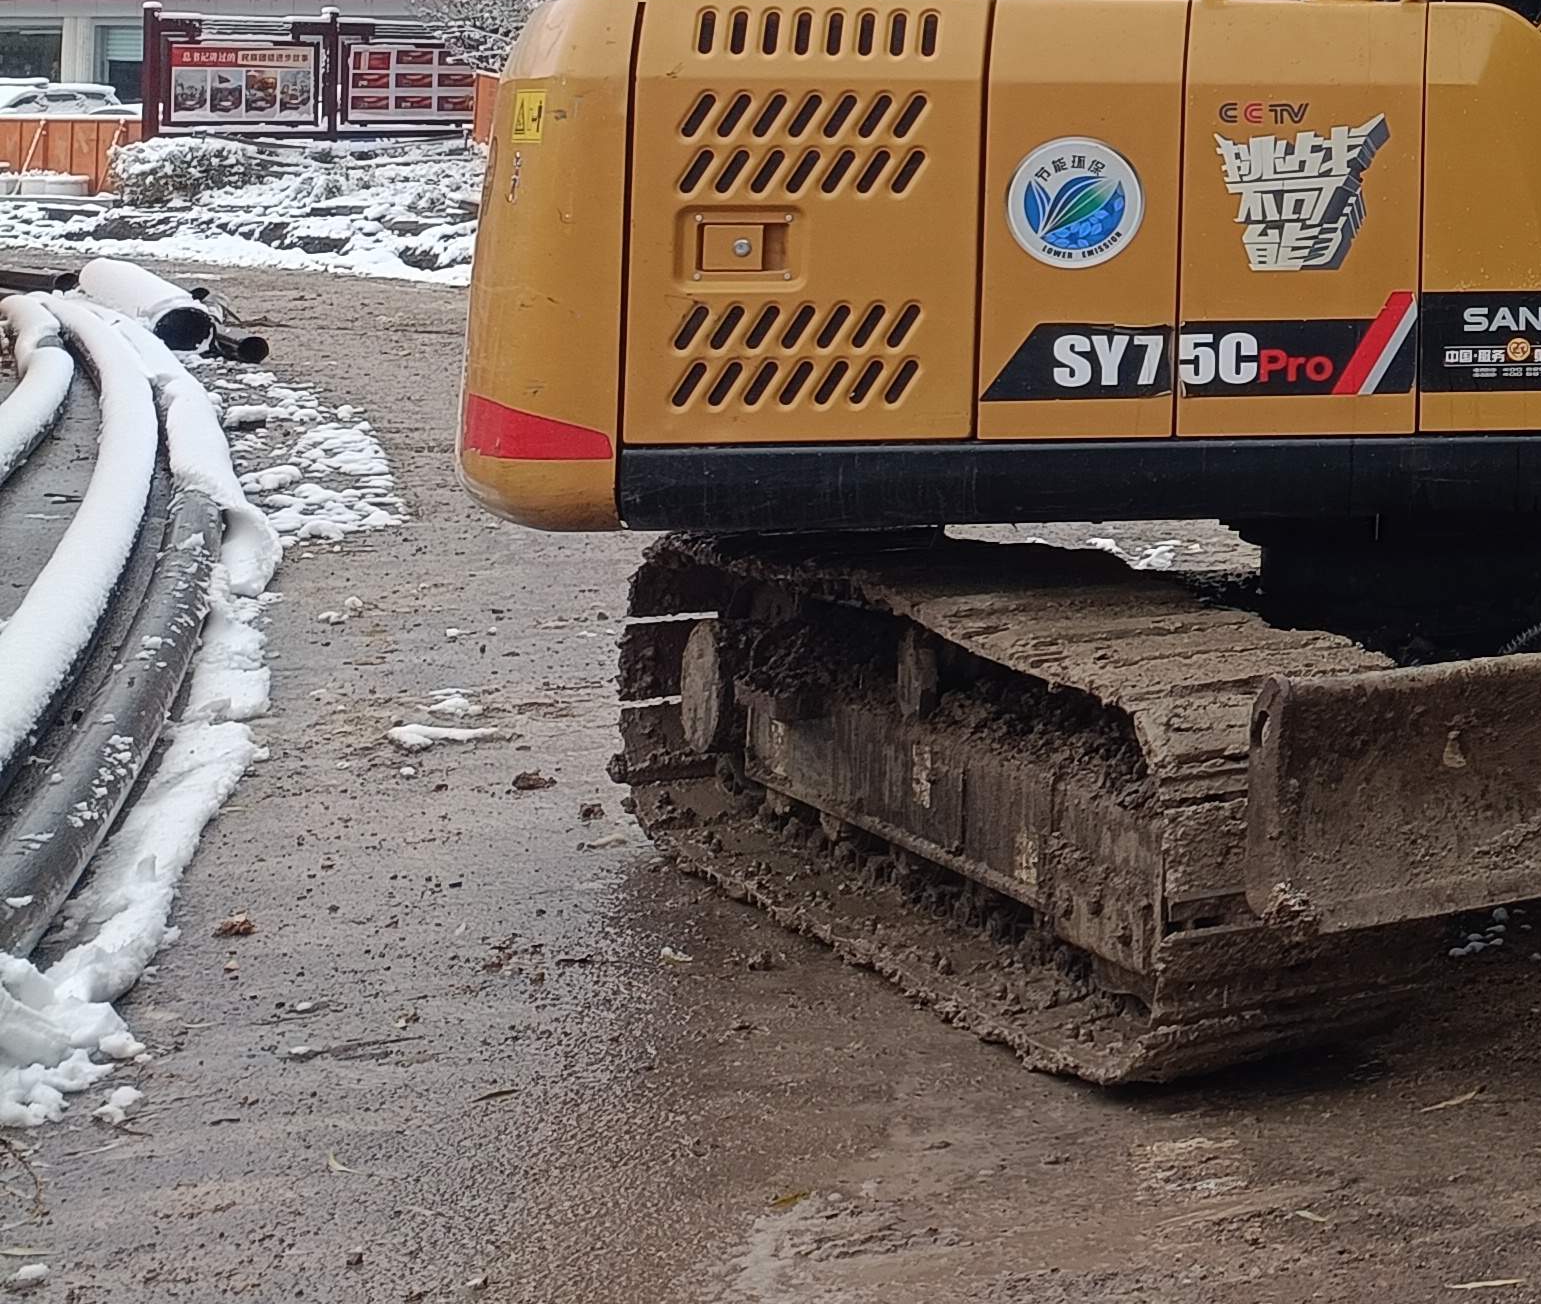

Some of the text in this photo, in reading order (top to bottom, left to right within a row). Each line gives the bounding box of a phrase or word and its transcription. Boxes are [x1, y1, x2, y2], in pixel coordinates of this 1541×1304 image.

[1219, 102, 1310, 125] CCTV
[1213, 112, 1386, 183] 挑战
[1034, 154, 1106, 183] 节能环保
[1041, 231, 1123, 260] LOWER EMISSION
